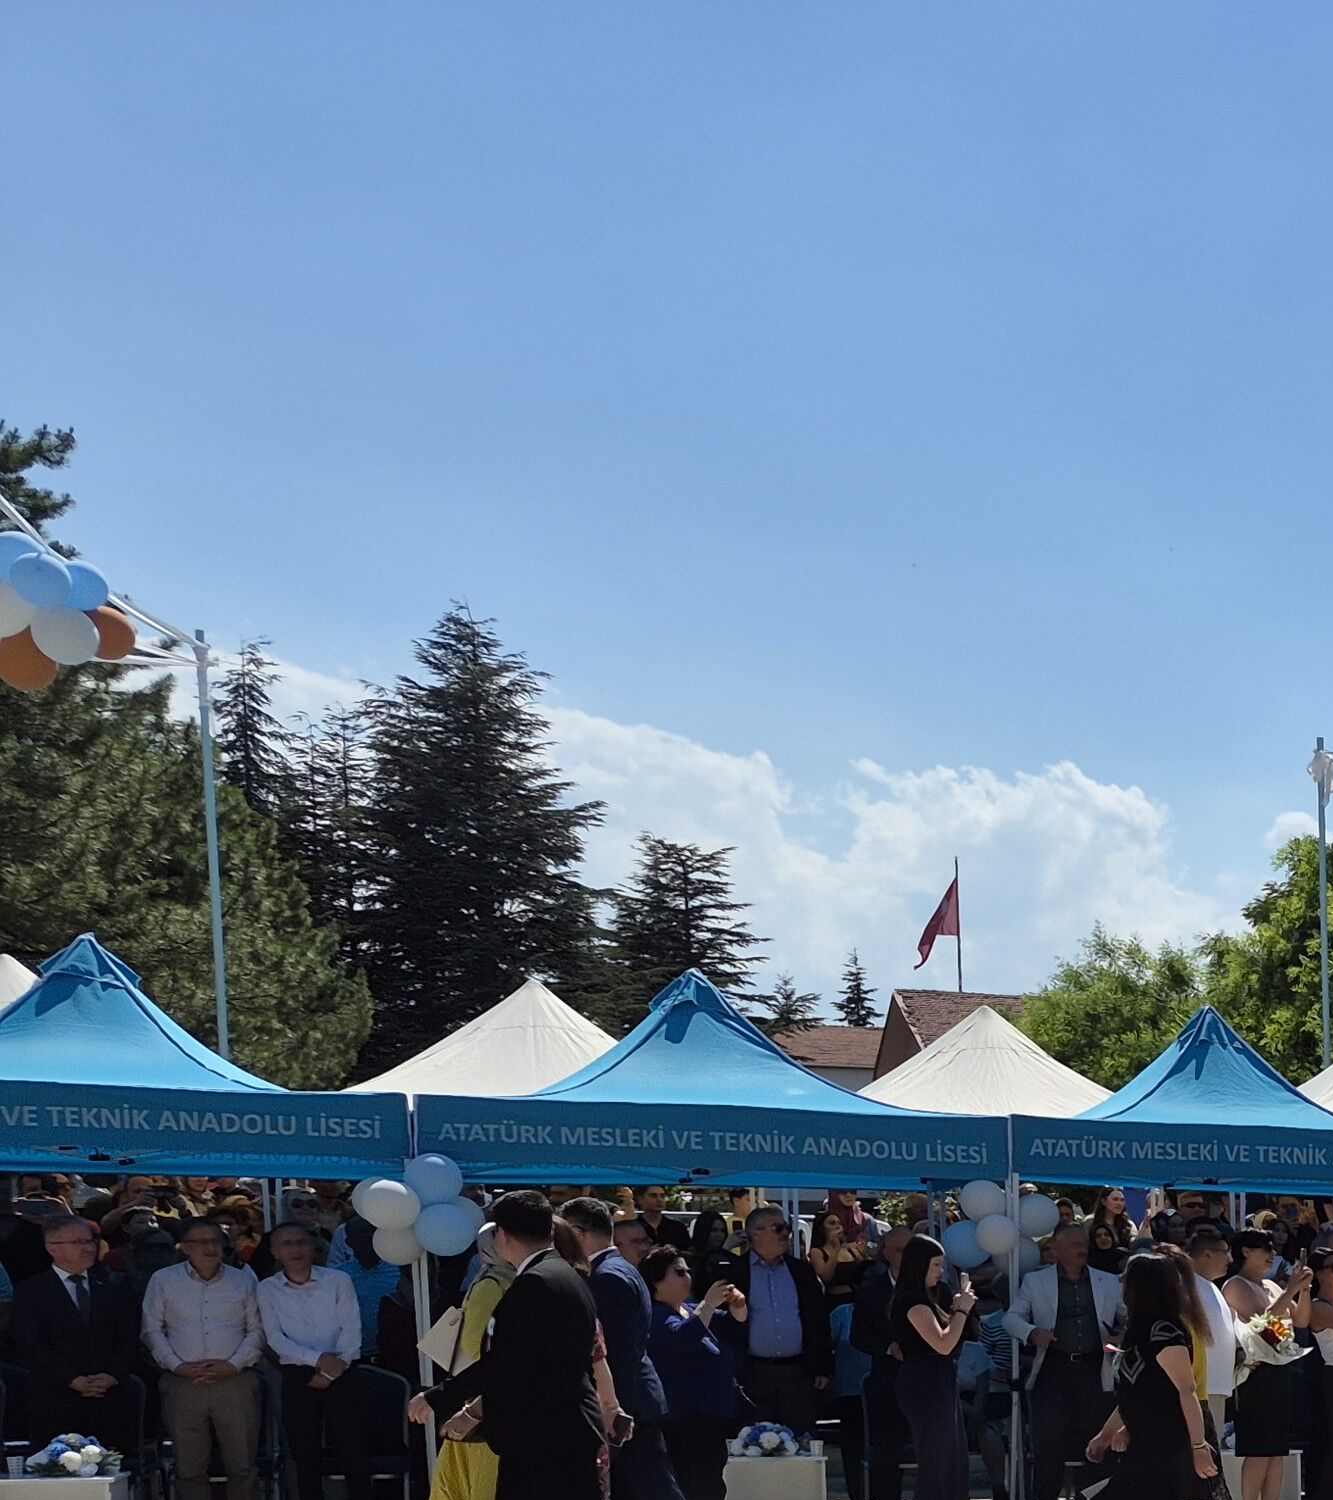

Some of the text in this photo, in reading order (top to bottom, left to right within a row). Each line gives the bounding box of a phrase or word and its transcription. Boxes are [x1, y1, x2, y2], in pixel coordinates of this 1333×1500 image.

[2, 1104, 381, 1139] VE TEKNİK ANADOLU LİSESİ
[438, 1119, 988, 1164] ATATÜRK MESLEKİ VE TEKNİK ANADOLU LİSESİ
[1029, 1136, 1125, 1159] ATATÜRK
[1131, 1140, 1218, 1162] MESLEKİ
[1224, 1144, 1250, 1162] VE
[1255, 1143, 1327, 1165] TEKNİK
